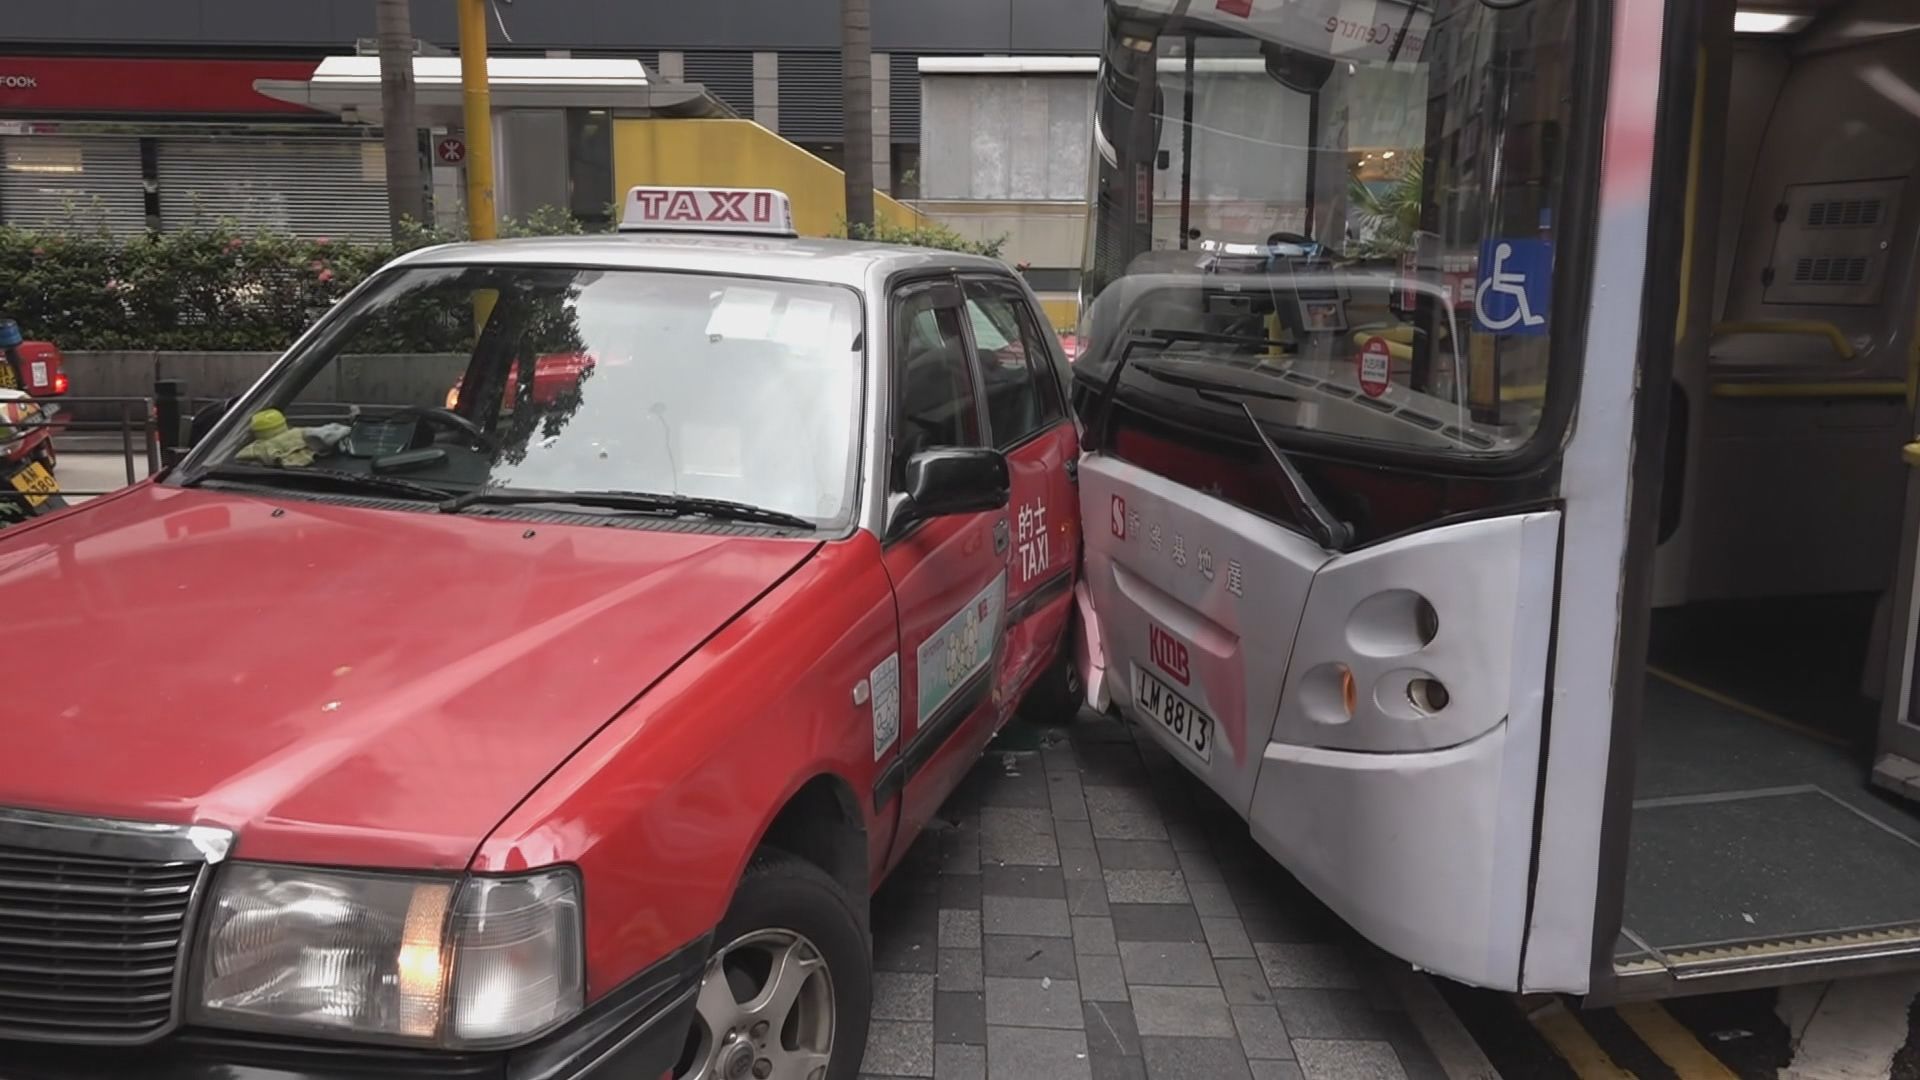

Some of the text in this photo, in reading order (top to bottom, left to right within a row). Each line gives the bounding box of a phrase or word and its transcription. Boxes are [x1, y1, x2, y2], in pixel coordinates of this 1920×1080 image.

[636, 190, 771, 222] TAXI
[1018, 496, 1046, 543] 的士
[1018, 532, 1049, 582] TAXI
[1149, 623, 1190, 687] KMB
[1140, 672, 1208, 752] LM 8813
